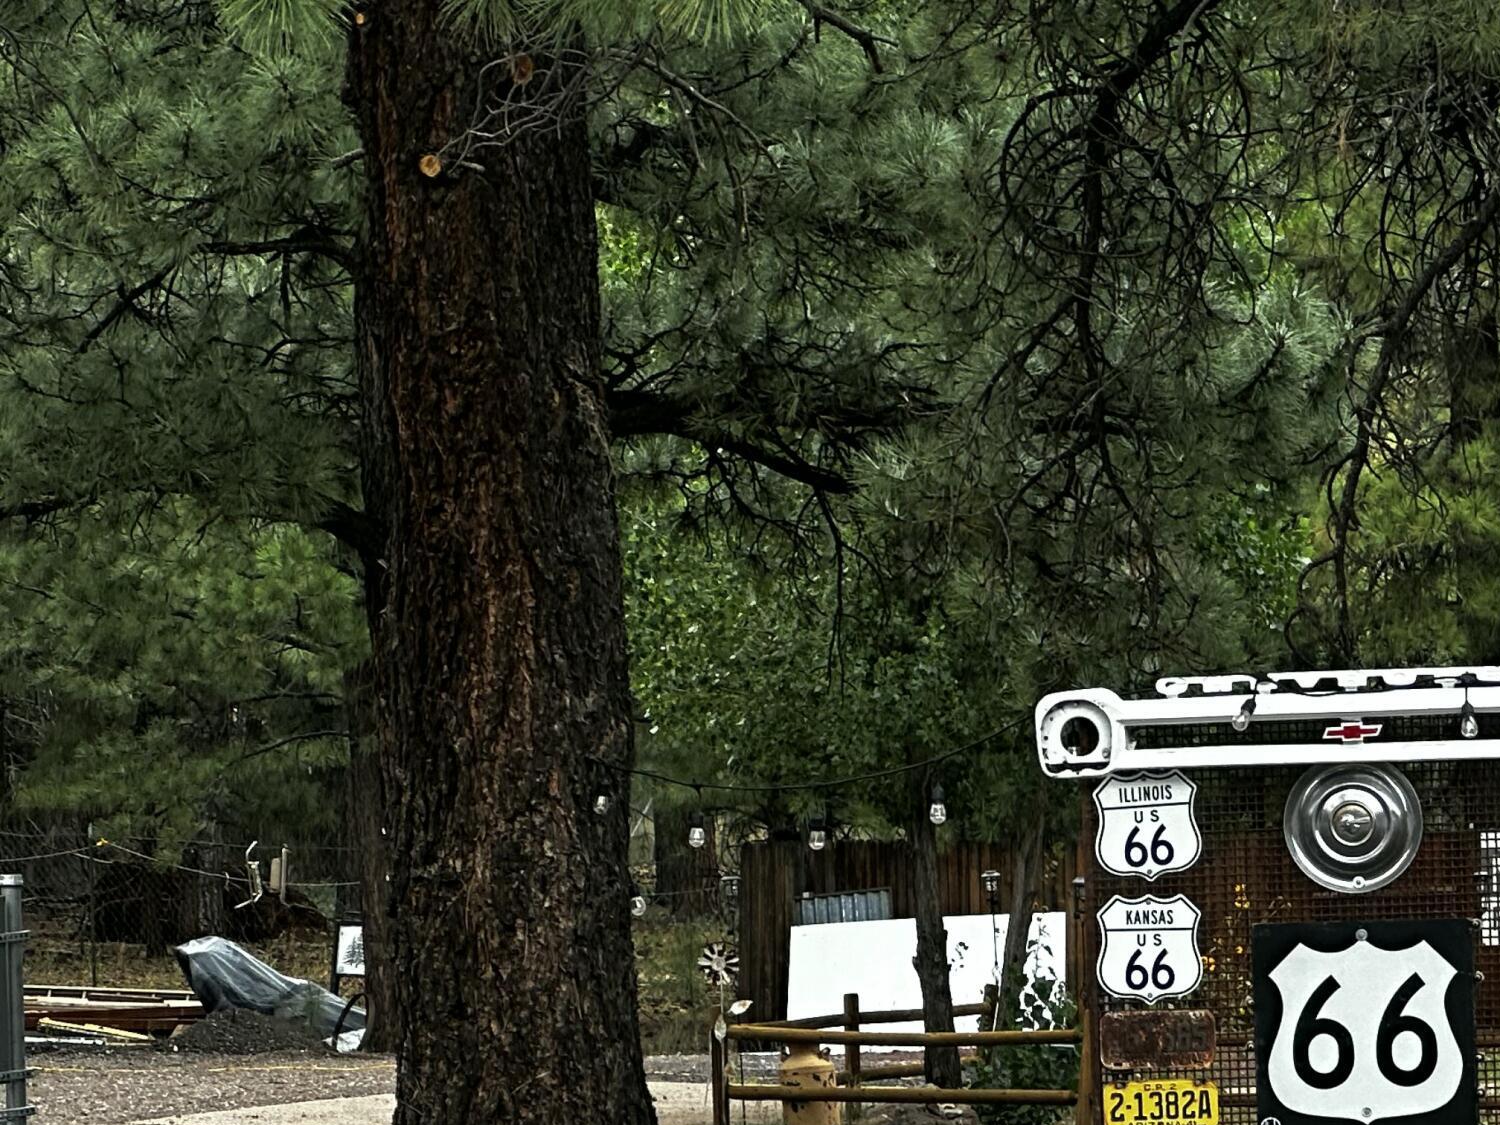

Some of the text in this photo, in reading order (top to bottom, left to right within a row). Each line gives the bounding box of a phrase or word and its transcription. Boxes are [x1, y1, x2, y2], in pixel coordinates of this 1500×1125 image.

[1119, 784, 1173, 803] ILLINOIS
[1124, 823, 1174, 868] 66
[1125, 909, 1174, 926] KANSAS
[1125, 948, 1175, 991] 66
[1292, 971, 1438, 1090] 66
[1110, 1090, 1212, 1122] 2-1382A
